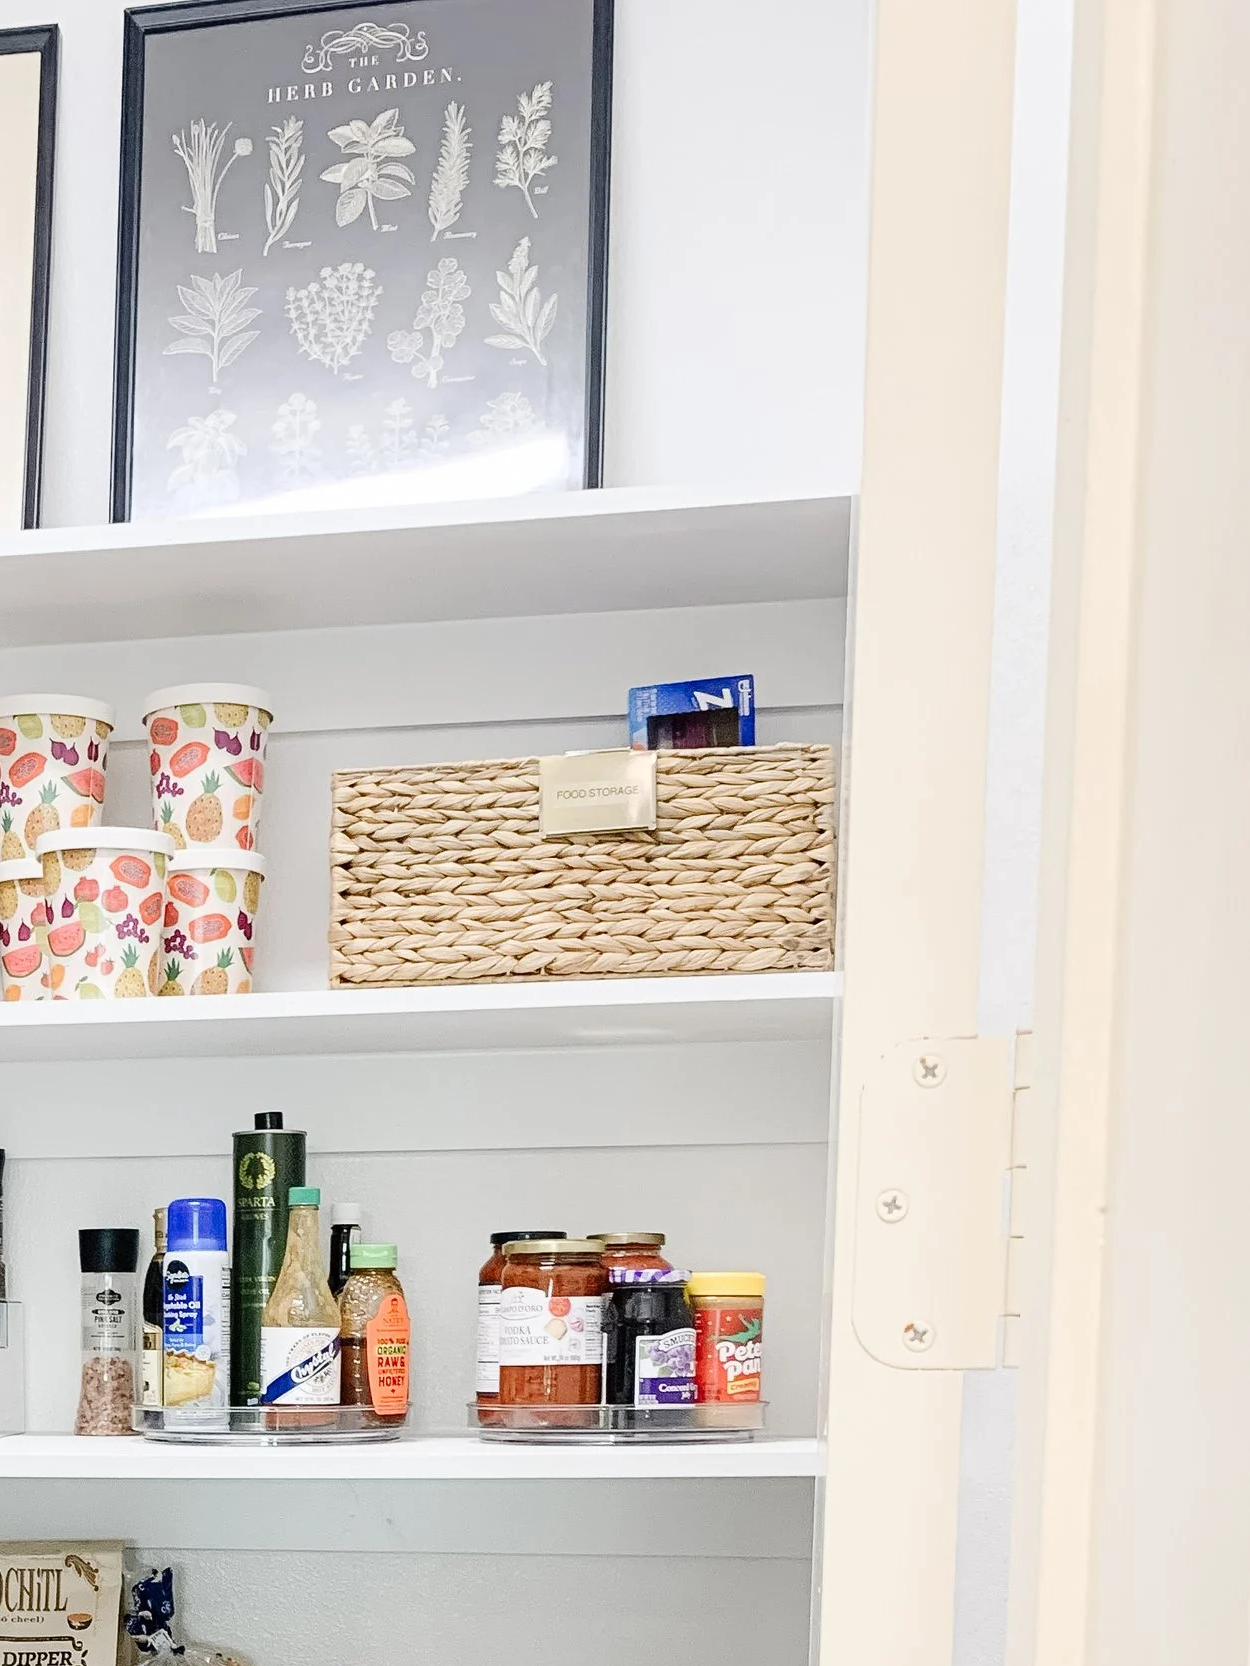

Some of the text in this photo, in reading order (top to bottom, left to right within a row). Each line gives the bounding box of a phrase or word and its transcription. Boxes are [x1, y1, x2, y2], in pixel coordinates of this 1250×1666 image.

[348, 55, 381, 68] THE
[267, 67, 463, 103] HERB GARDEN.
[556, 785, 639, 800] FOOD STORAGE
[237, 1196, 276, 1208] SPARTA
[188, 1301, 201, 1309] Oil
[520, 1336, 549, 1345] SAUCE
[376, 1346, 406, 1355] ORGANIC
[290, 1341, 336, 1384] Crystal
[723, 1357, 761, 1382] Pan
[378, 1376, 406, 1387] HONEY
[11, 1614, 45, 1624] cheel)
